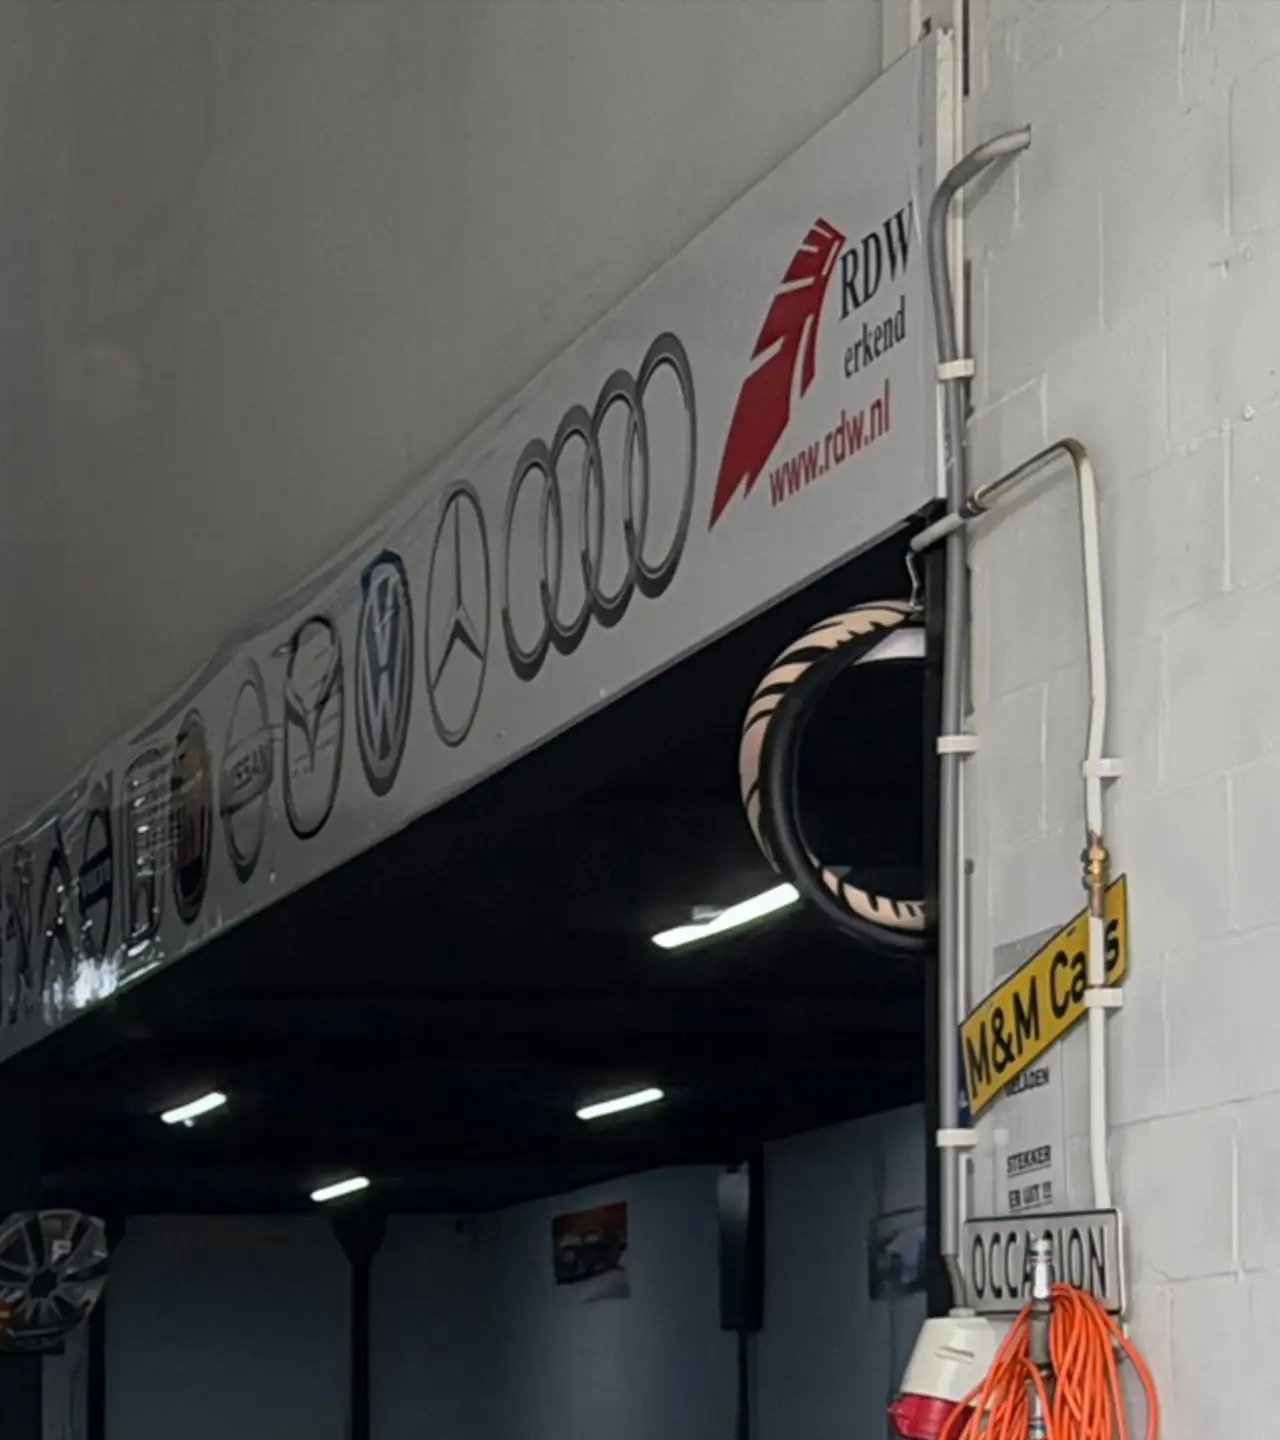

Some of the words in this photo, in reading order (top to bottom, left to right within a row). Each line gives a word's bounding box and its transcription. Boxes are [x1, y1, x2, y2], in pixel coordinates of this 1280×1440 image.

[840, 201, 914, 320] RDW
[844, 296, 906, 378] erkend
[769, 379, 890, 507] www.rdw.nl
[966, 975, 1040, 1098] M&M
[1049, 919, 1120, 1019] Cas
